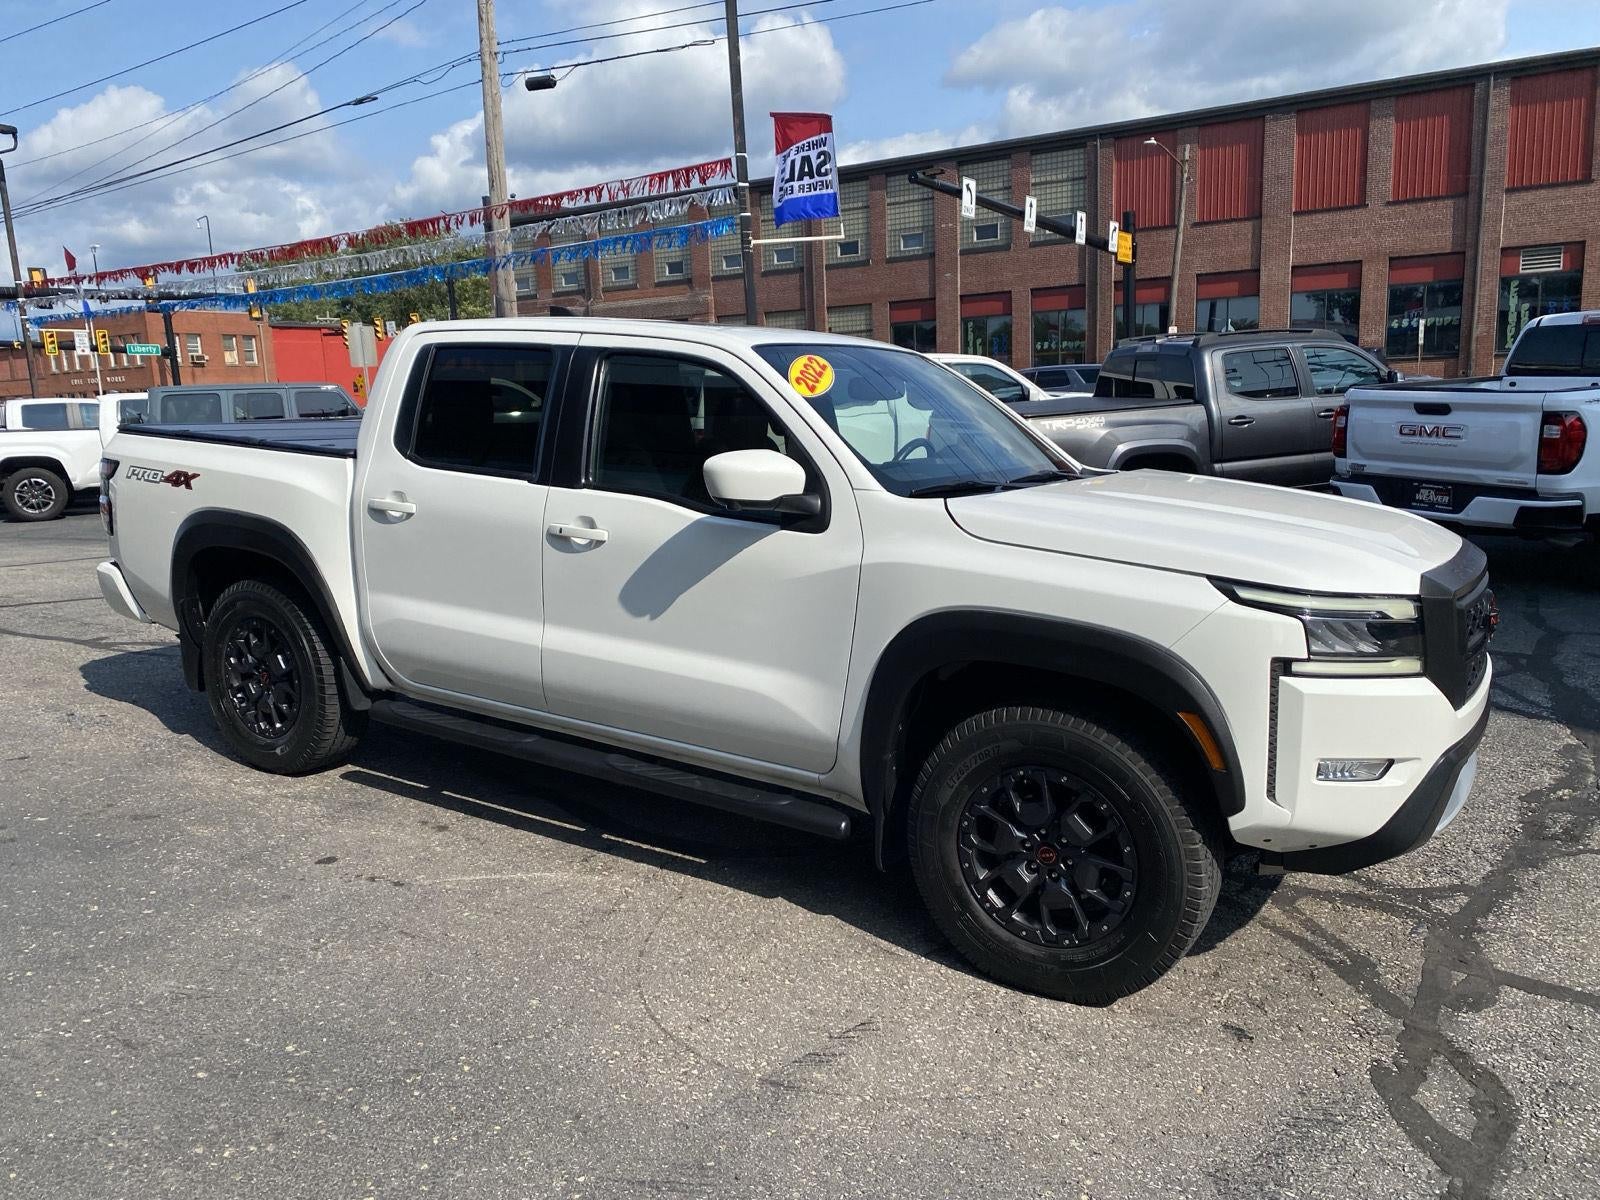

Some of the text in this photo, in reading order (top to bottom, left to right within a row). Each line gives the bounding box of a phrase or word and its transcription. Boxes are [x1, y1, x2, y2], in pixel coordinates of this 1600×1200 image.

[130, 344, 157, 354] Liberty
[795, 356, 828, 394] 2022
[1399, 424, 1464, 439] GMC
[1415, 493, 1449, 504] WEAVER
